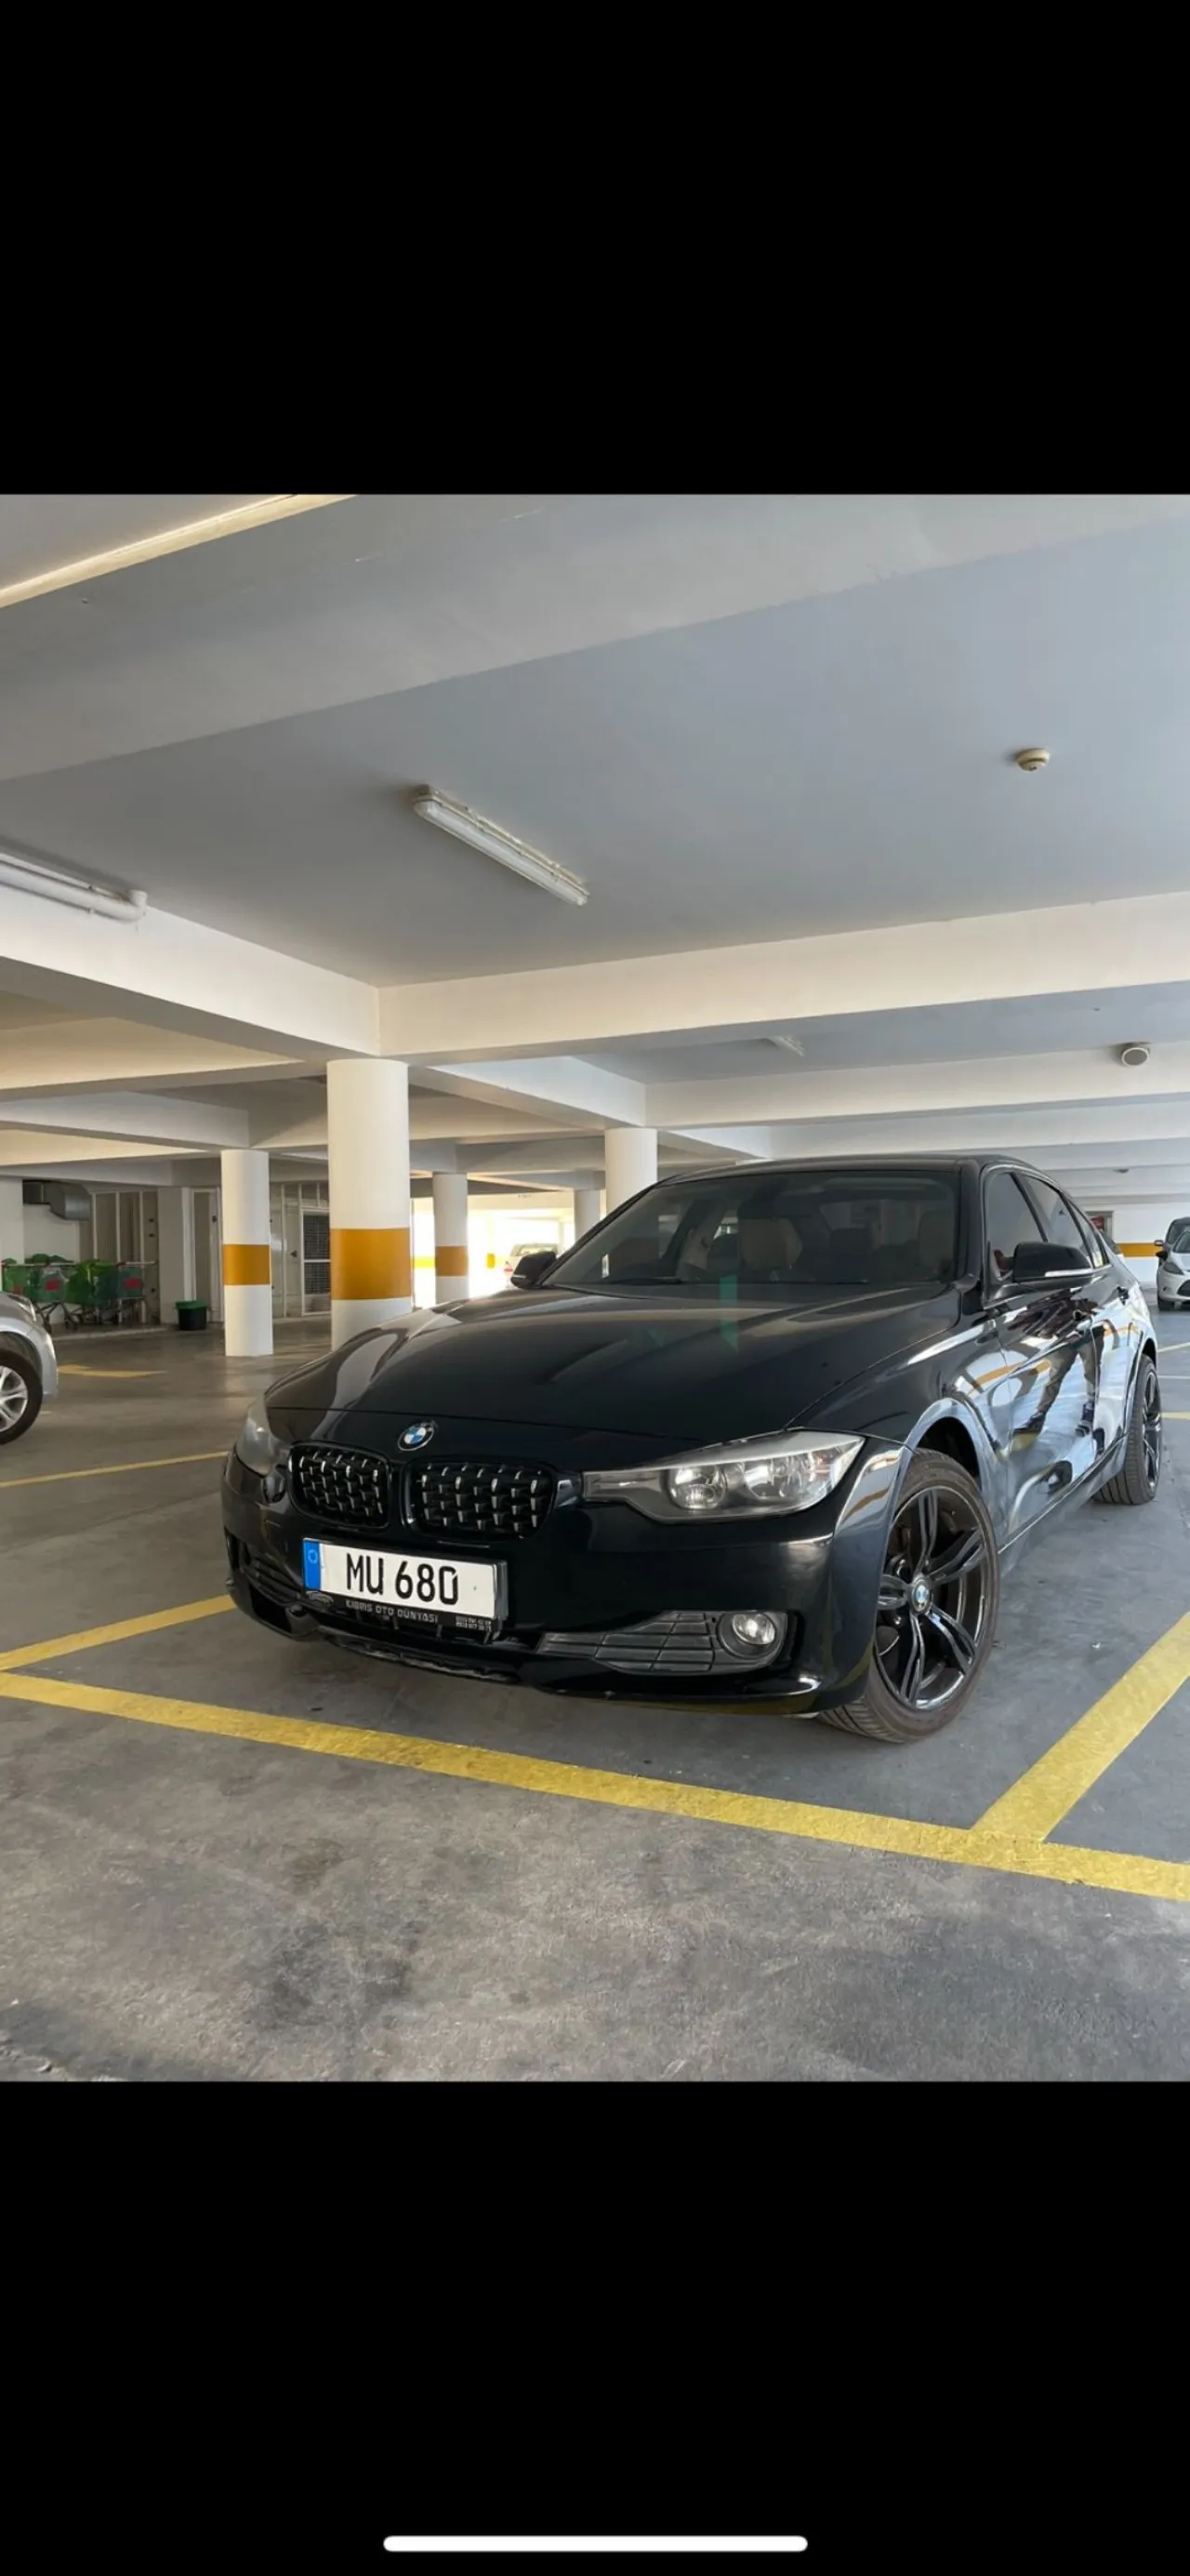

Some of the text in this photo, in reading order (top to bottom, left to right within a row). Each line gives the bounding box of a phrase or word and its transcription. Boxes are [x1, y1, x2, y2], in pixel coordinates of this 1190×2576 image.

[346, 1552, 458, 1605] MU 680
[376, 1605, 394, 1616] OTO
